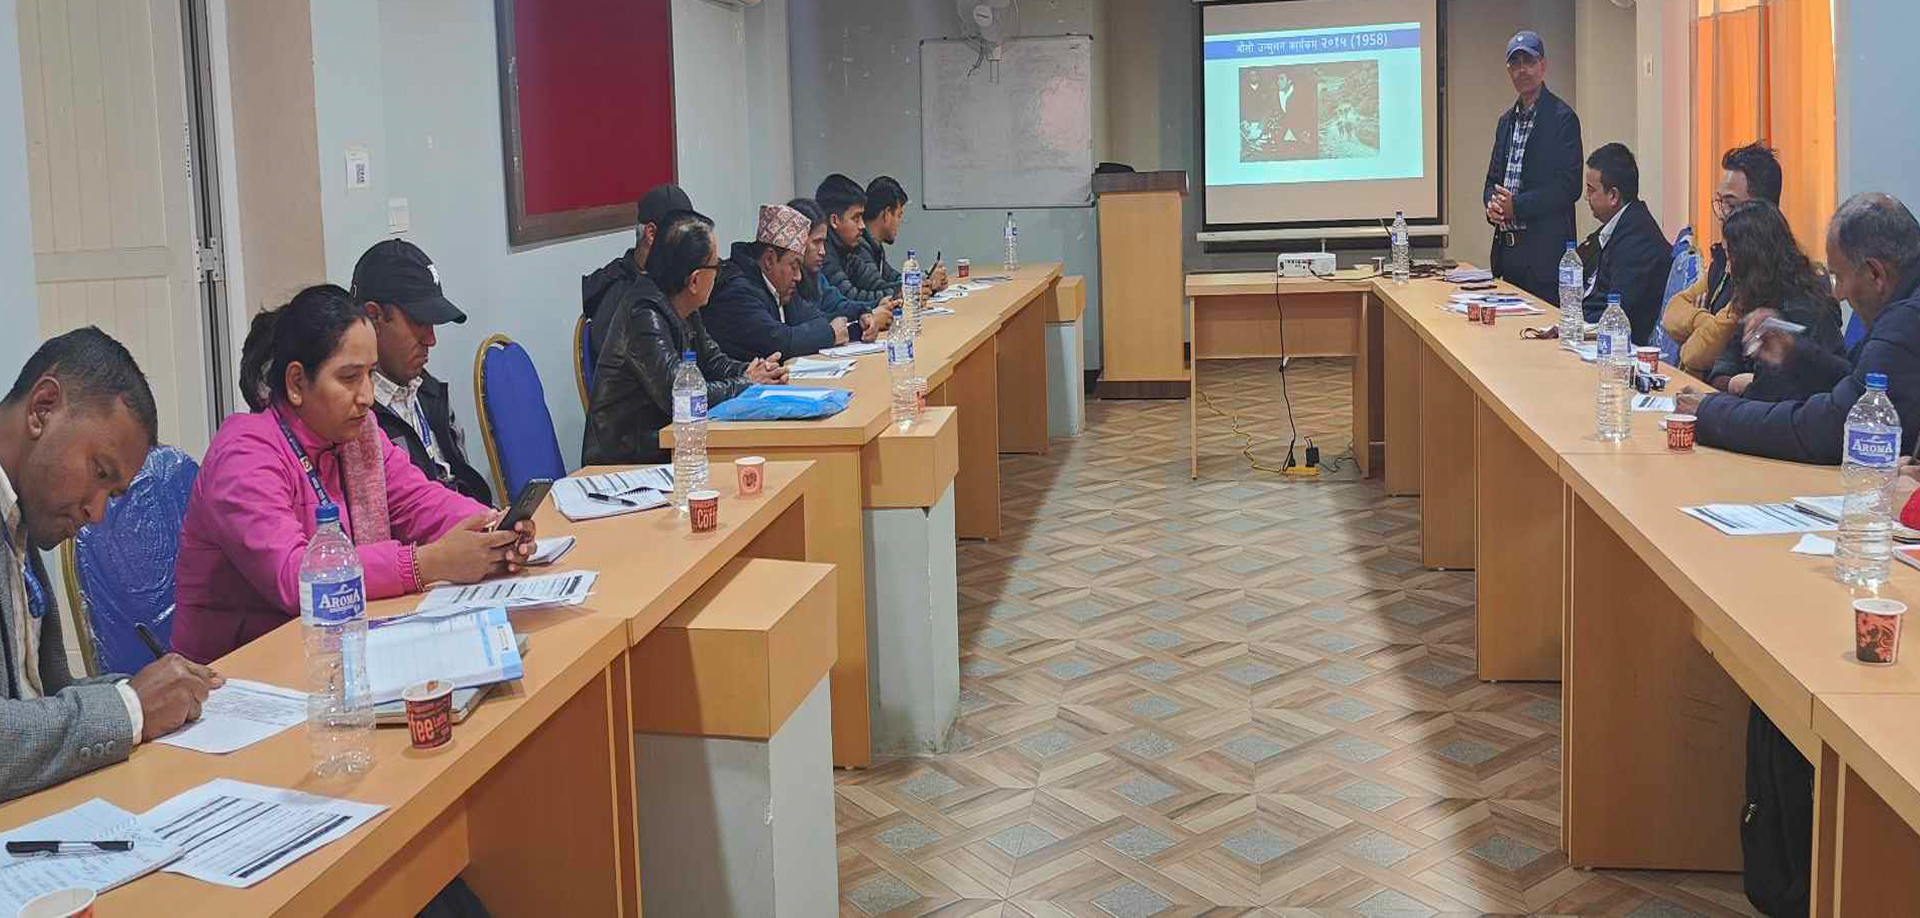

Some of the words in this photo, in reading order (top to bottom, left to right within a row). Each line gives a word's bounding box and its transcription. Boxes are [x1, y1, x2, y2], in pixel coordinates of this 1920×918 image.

[1350, 33, 1388, 48] (1958)
[1851, 438, 1894, 453] AROMA
[317, 587, 360, 609] AROMA
